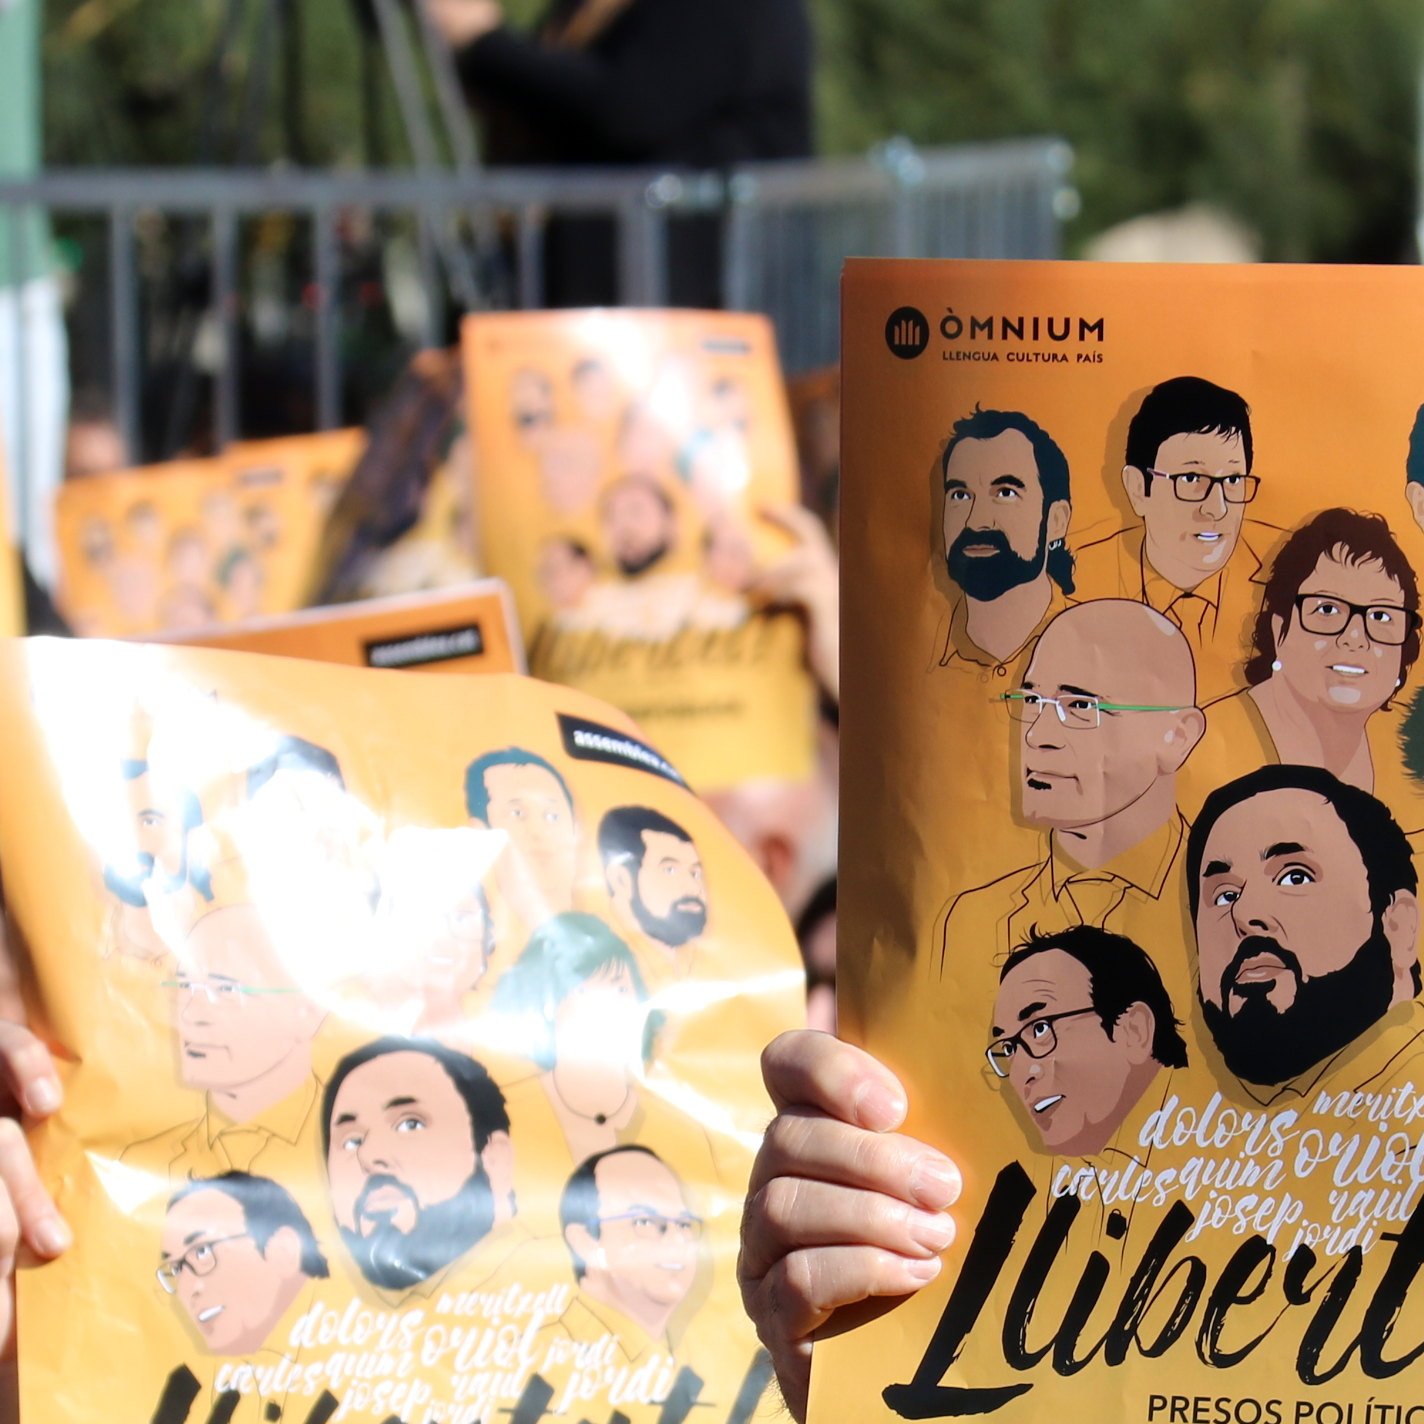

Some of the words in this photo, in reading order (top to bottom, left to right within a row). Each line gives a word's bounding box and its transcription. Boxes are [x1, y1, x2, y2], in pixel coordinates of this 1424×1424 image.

[940, 307, 1104, 342] ÒMNIUM
[942, 351, 999, 362] LLENGUA
[1006, 352, 1069, 363] CULTURA
[1076, 350, 1103, 363] PAÍS
[1138, 1094, 1300, 1157] dolors
[1052, 1152, 1179, 1207] carles
[1175, 1151, 1287, 1200] quim
[1188, 1189, 1305, 1244] josep
[1282, 1220, 1379, 1264] jordi
[289, 1298, 425, 1354] dolors
[435, 1283, 570, 1318] meritxell
[215, 1356, 328, 1396] carles
[422, 1306, 547, 1369] oriol
[543, 1334, 620, 1375] jordi
[332, 1381, 431, 1424] josep
[553, 1357, 678, 1416] jordi
